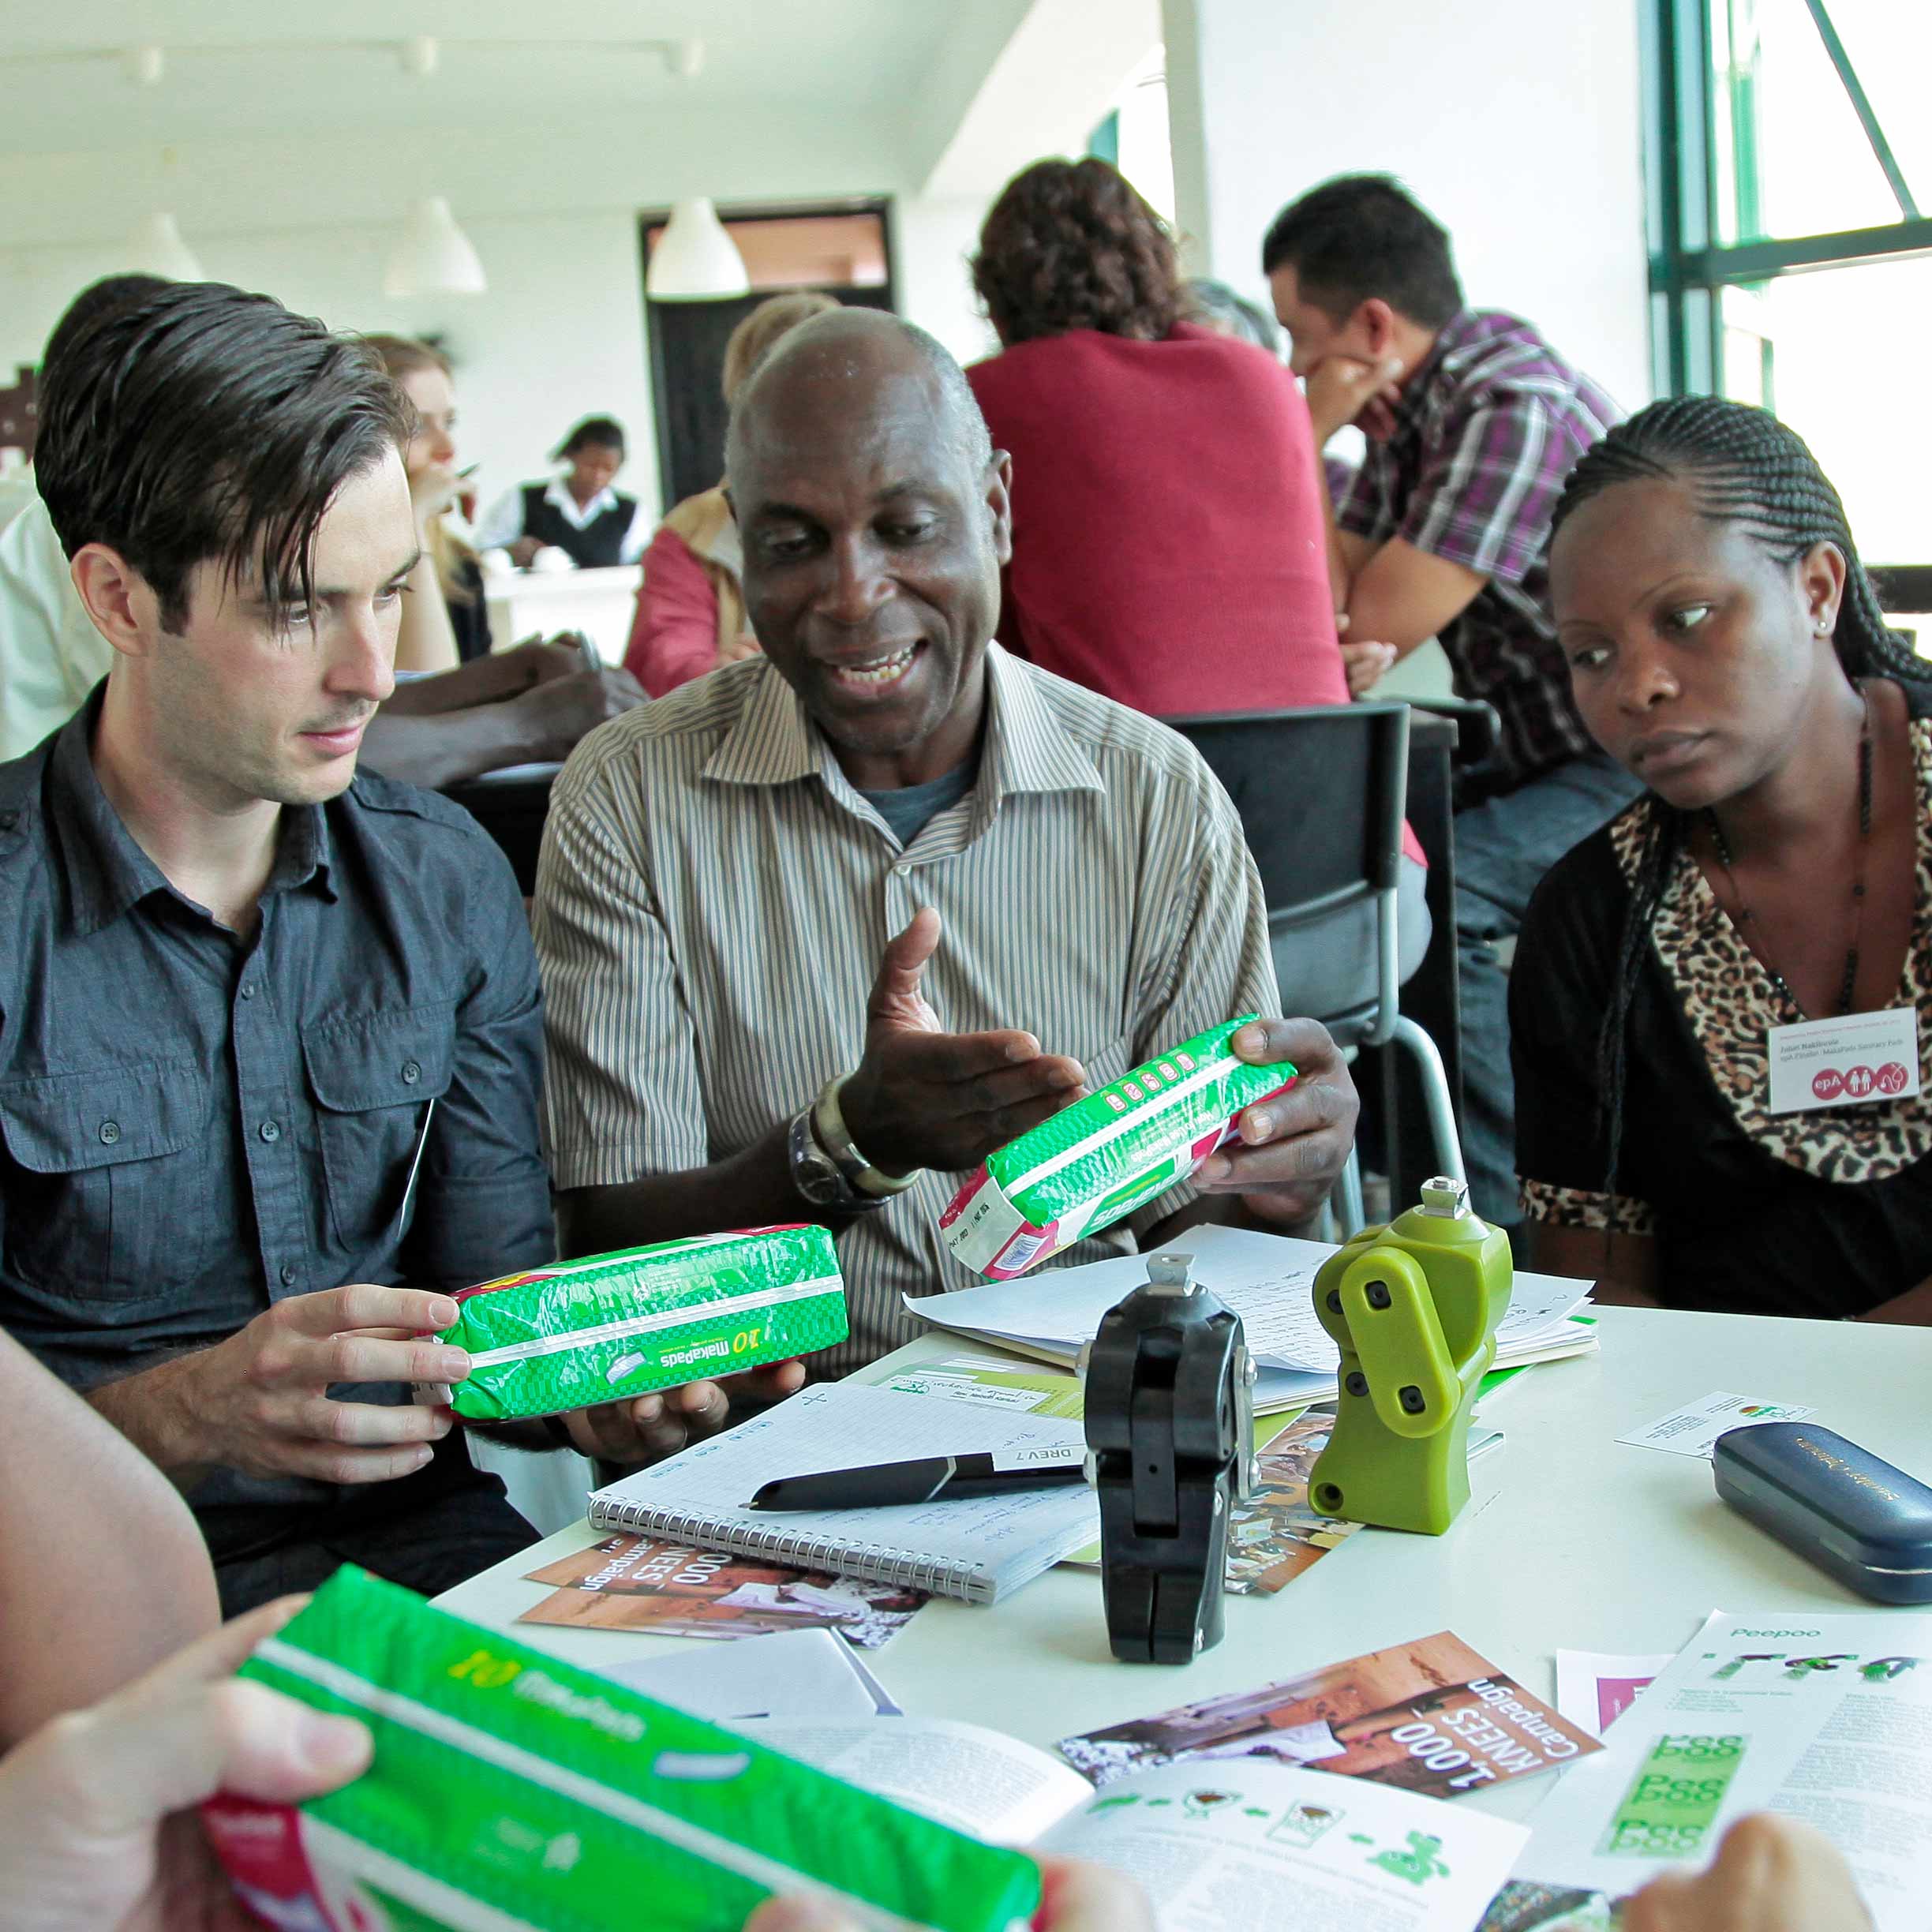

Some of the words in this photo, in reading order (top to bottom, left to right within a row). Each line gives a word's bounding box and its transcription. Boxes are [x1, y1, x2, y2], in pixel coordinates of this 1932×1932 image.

[1814, 1076, 1842, 1091] epA
[660, 1339, 730, 1368] MakaPads
[732, 1327, 761, 1355] 10
[1017, 1451, 1024, 1461] 7
[1028, 1449, 1072, 1461] DREV
[631, 1547, 696, 1582] NEES
[671, 1549, 733, 1586] 000
[1731, 1628, 1822, 1639] Peepoo
[1467, 1677, 1580, 1760] Campaign
[1441, 1709, 1544, 1774] KNEES
